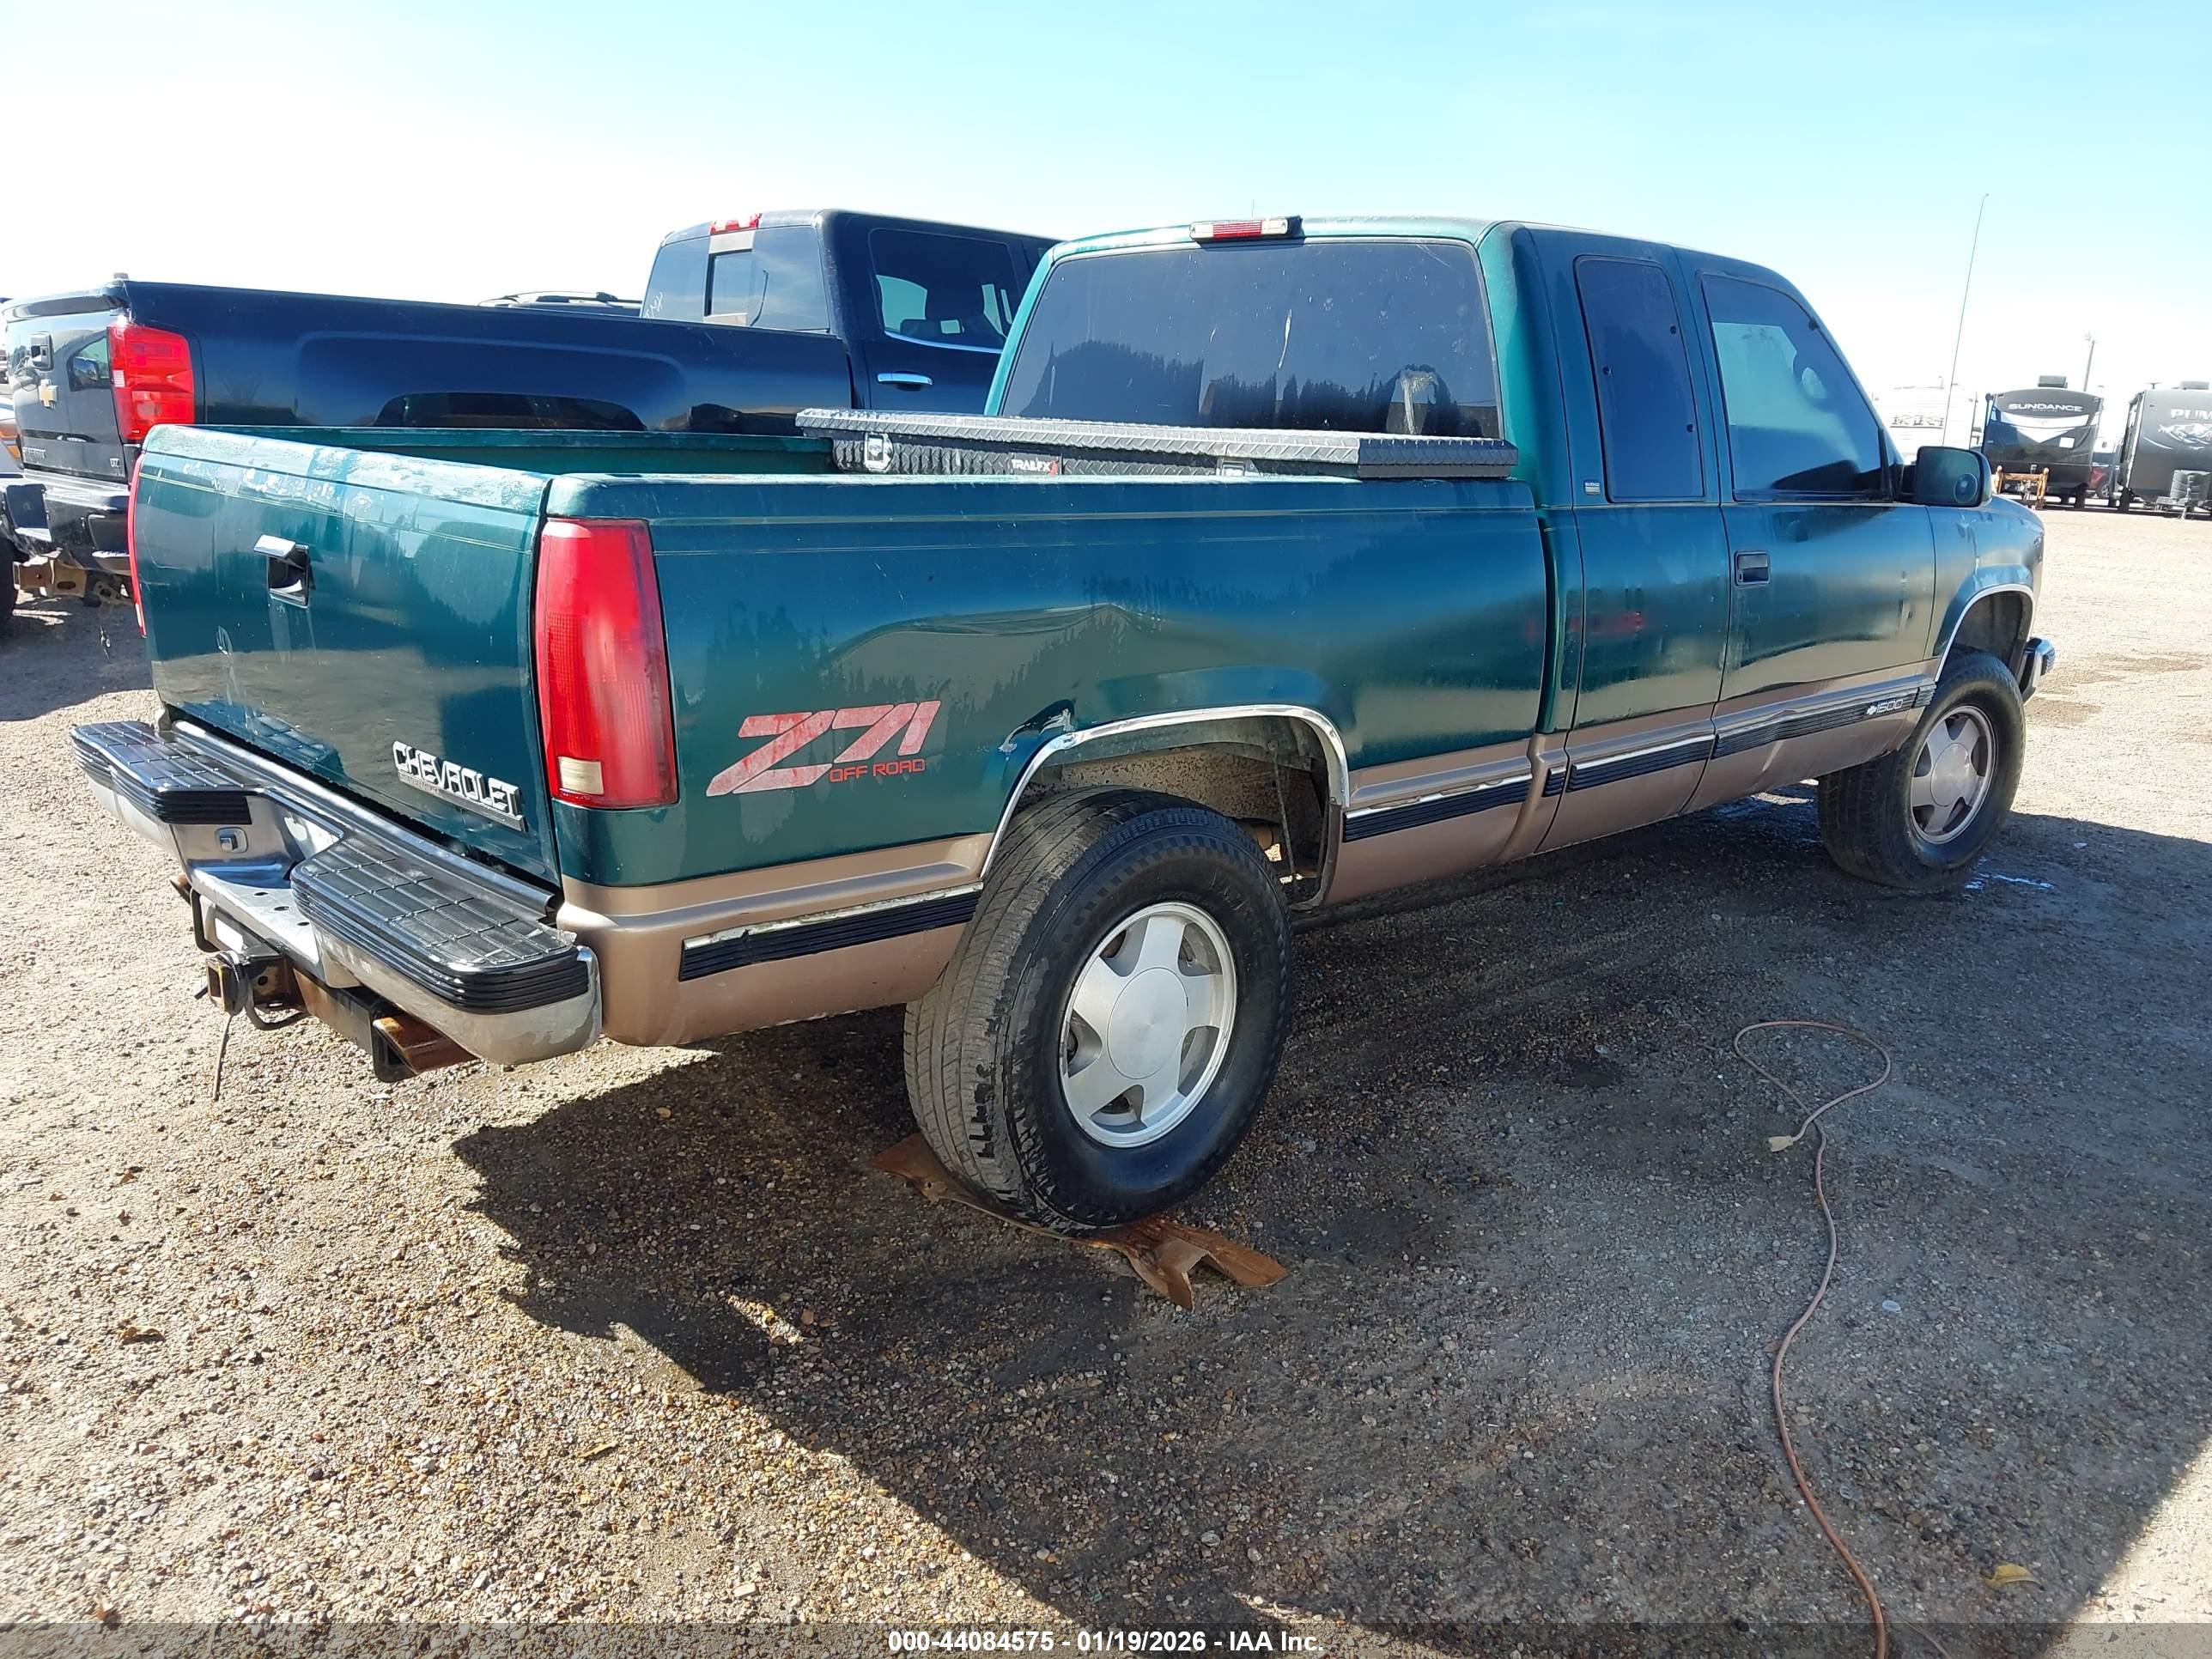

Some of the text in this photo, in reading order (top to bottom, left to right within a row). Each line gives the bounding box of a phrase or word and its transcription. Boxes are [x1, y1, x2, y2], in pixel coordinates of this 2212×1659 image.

[2008, 403, 2083, 412] SUNDANCE
[1877, 699, 1904, 714] 1500
[705, 700, 941, 797] Z71
[392, 740, 520, 817] CHEVROLET
[829, 758, 927, 783] OFF ROAD
